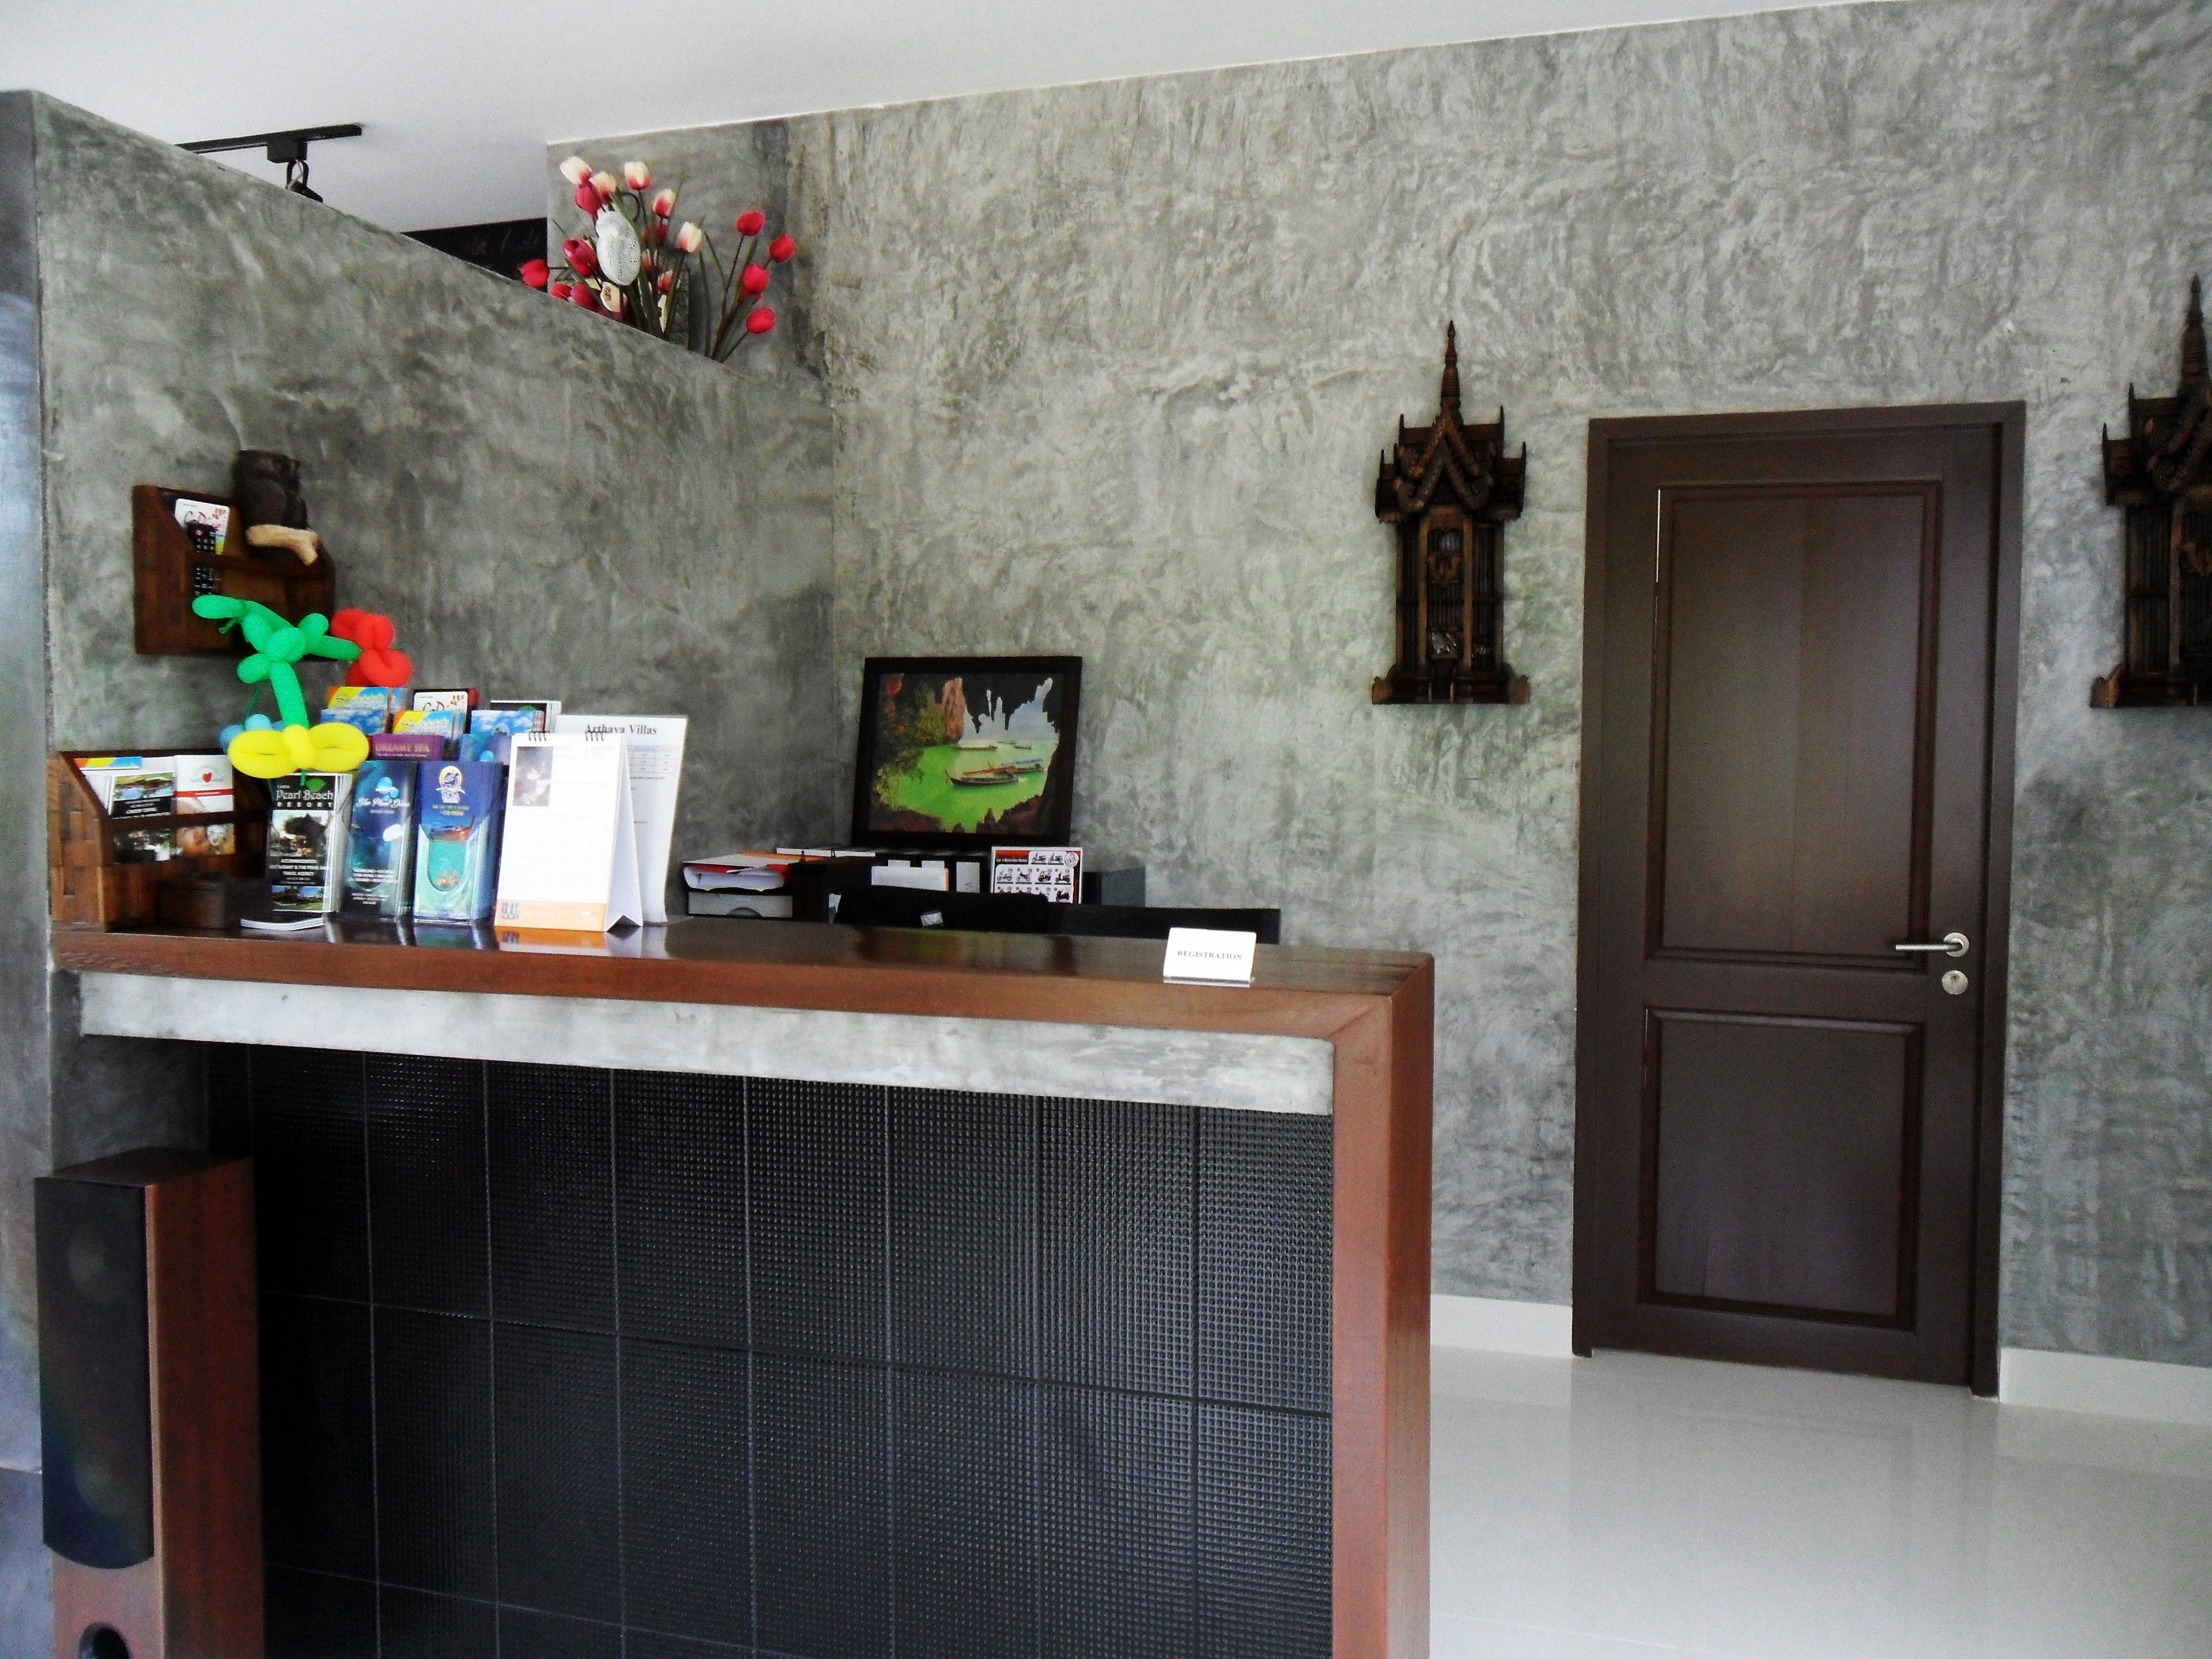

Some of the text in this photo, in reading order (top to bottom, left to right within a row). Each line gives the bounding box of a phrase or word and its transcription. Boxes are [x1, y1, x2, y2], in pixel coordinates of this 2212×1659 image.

[630, 725, 657, 734] Villas
[276, 789, 334, 801] Pearl Beach
[1177, 950, 1243, 959] REGISTRATION
